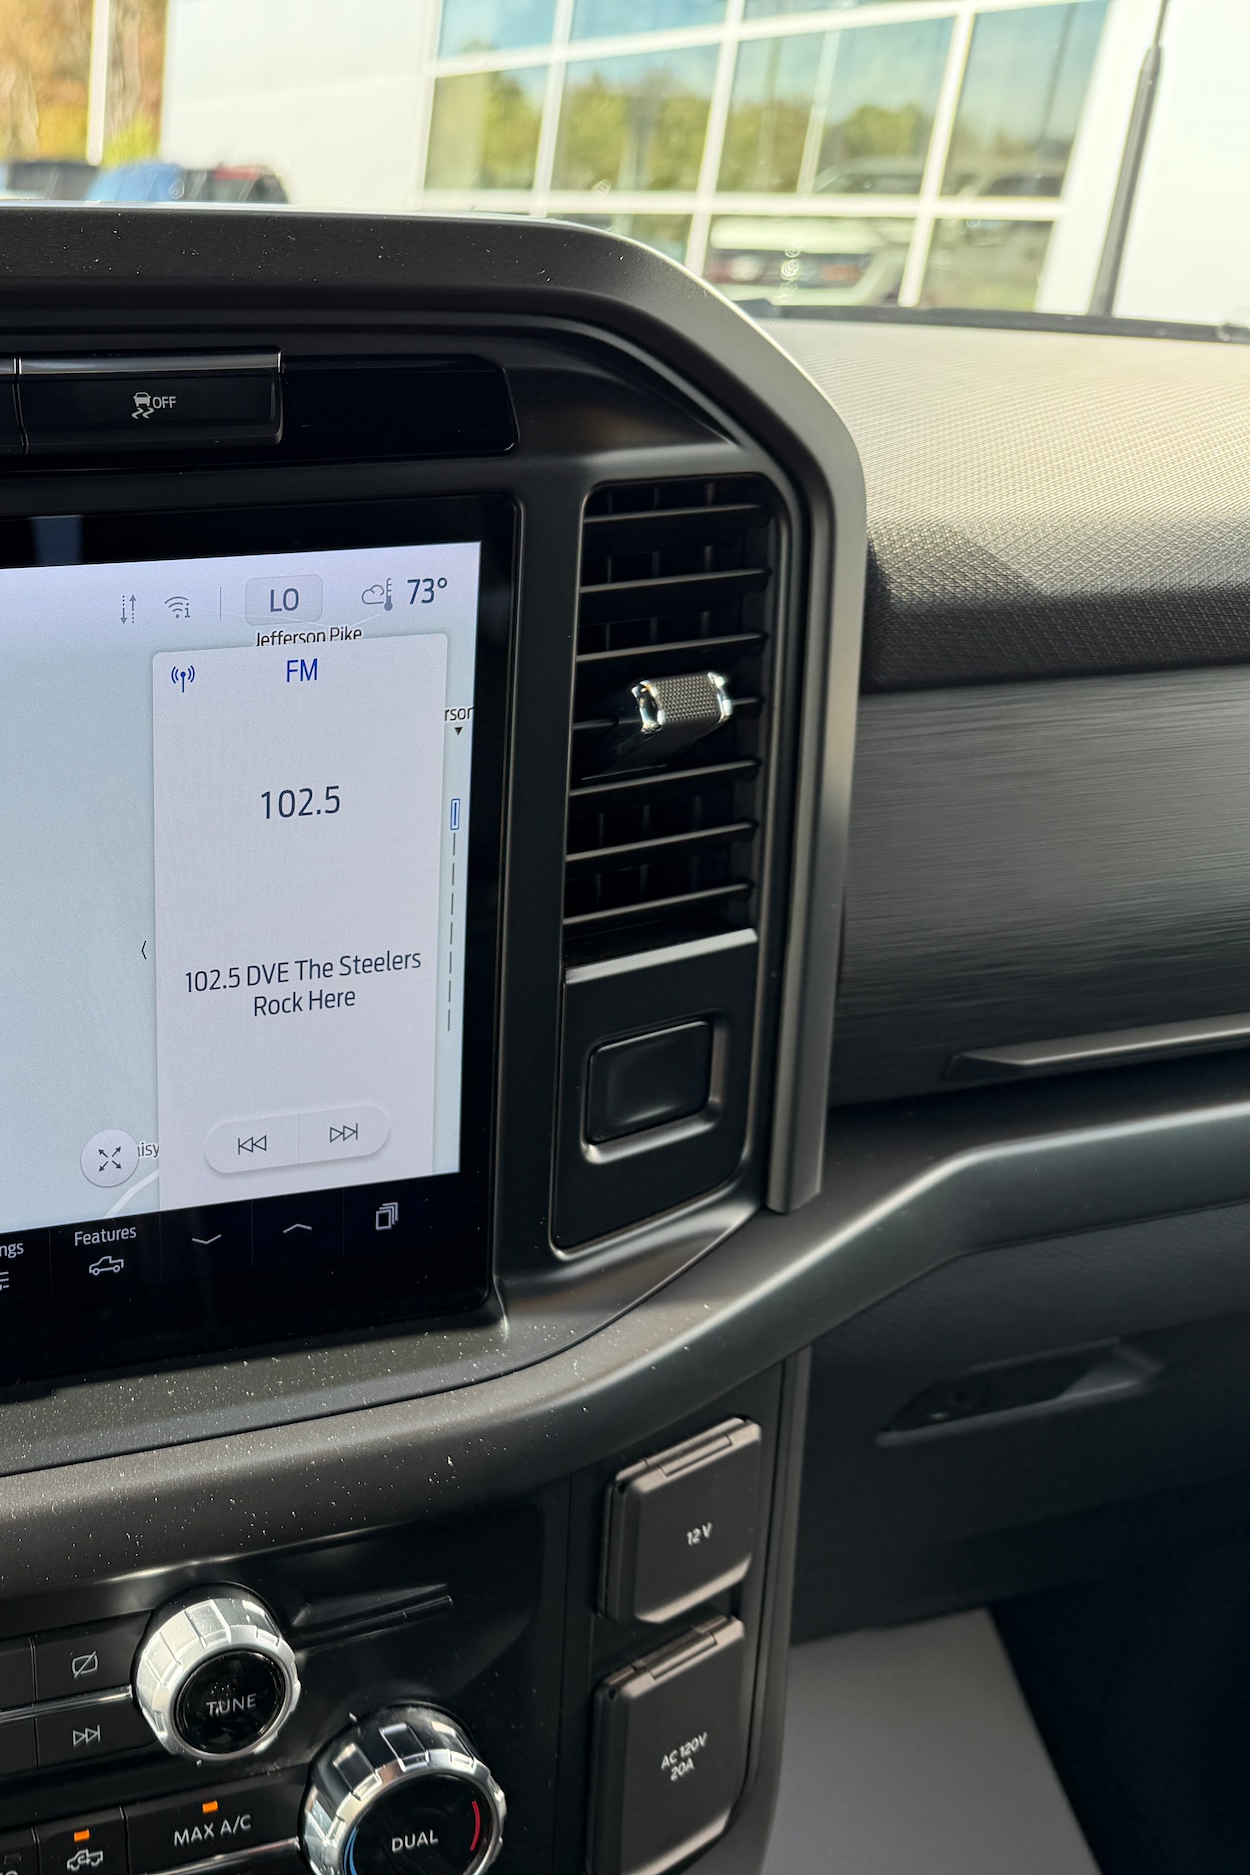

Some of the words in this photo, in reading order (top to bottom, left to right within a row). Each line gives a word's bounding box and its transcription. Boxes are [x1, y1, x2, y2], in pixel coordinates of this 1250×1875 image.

[152, 396, 177, 409] OFF
[269, 588, 300, 614] LO
[406, 576, 449, 606] 73°
[256, 629, 326, 646] Jefferson
[329, 625, 363, 641] Pike
[286, 658, 319, 683] FM
[260, 785, 342, 820] 102.5
[185, 967, 241, 994] 102.5
[246, 962, 290, 987] DVE
[295, 956, 334, 982] The
[338, 950, 422, 977] Steelers
[253, 992, 304, 1018] Rock
[308, 988, 356, 1011] Here
[73, 1225, 137, 1248] Features
[206, 1694, 257, 1718] TUNE
[661, 1749, 679, 1771] AC
[680, 1731, 708, 1758] 120V
[669, 1758, 695, 1782] 20A
[174, 1822, 215, 1847] MAX
[220, 1814, 252, 1837] A/C
[391, 1828, 439, 1853] DUAL
